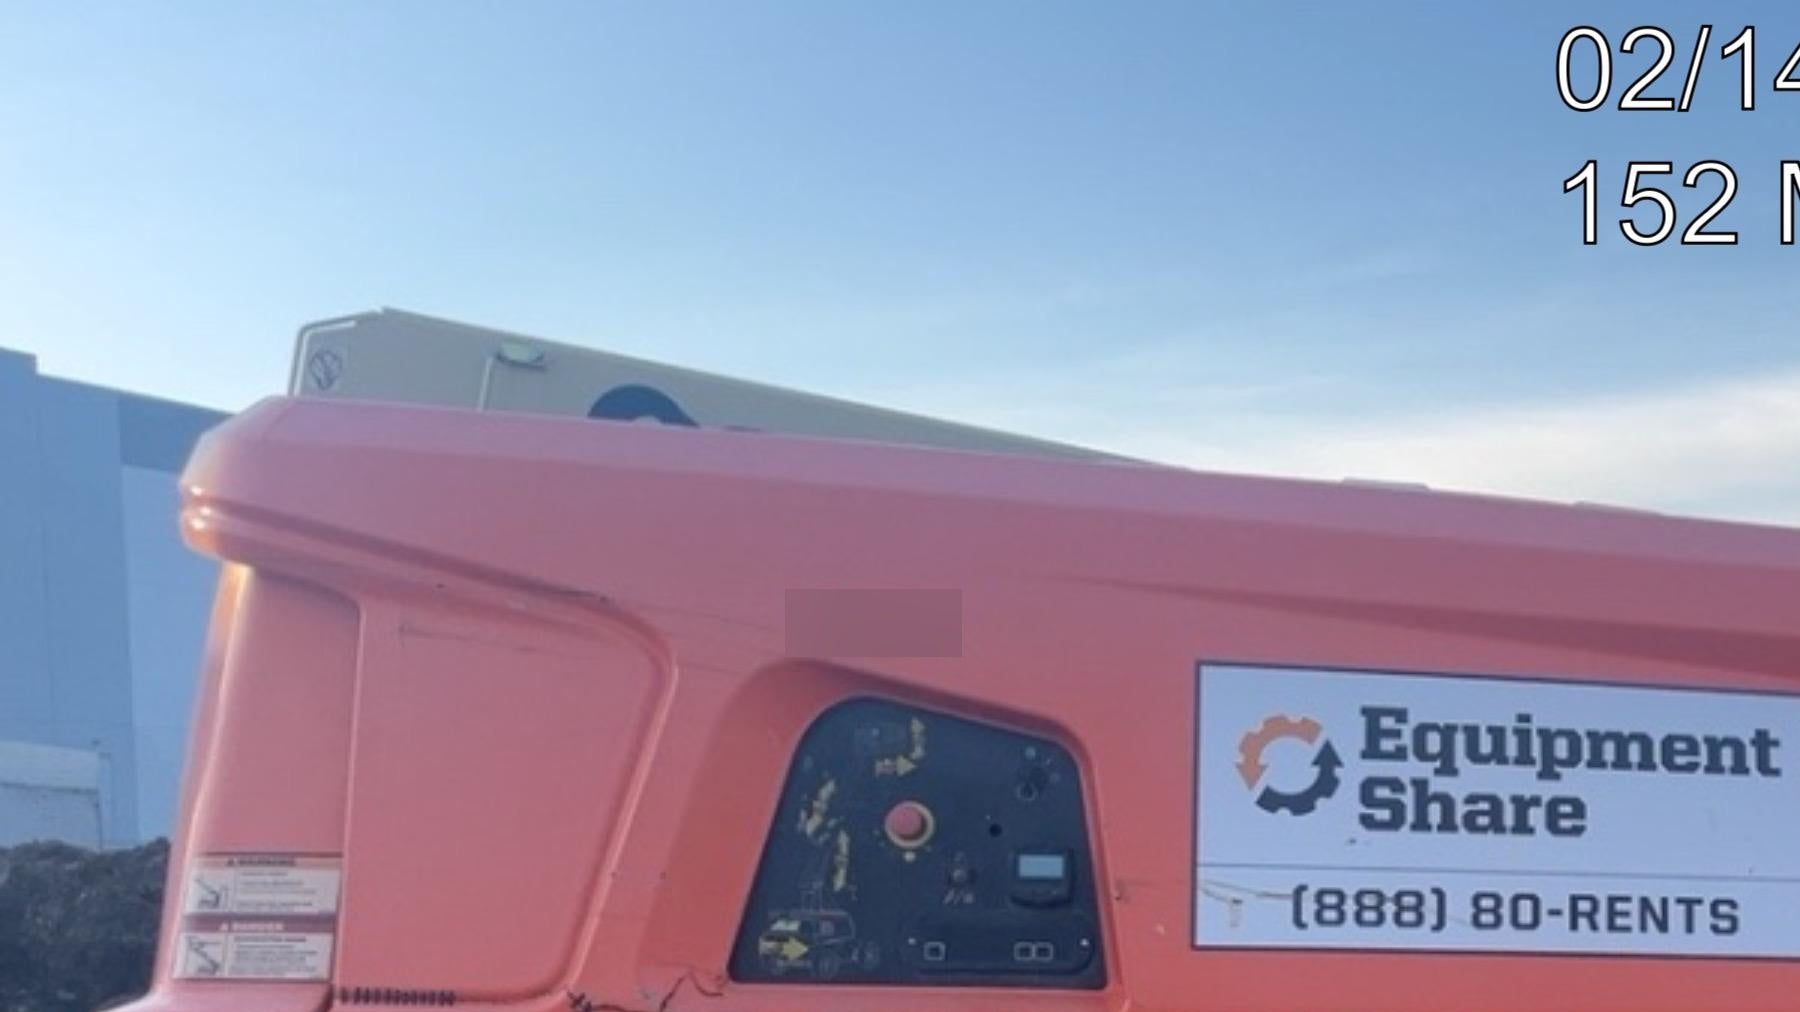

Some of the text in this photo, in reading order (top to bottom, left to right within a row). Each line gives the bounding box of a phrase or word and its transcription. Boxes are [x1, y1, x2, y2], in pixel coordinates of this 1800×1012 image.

[1358, 705, 1782, 780] Equipment
[1358, 776, 1588, 838] Share
[1291, 884, 1740, 936] (888) 80-RENTS
